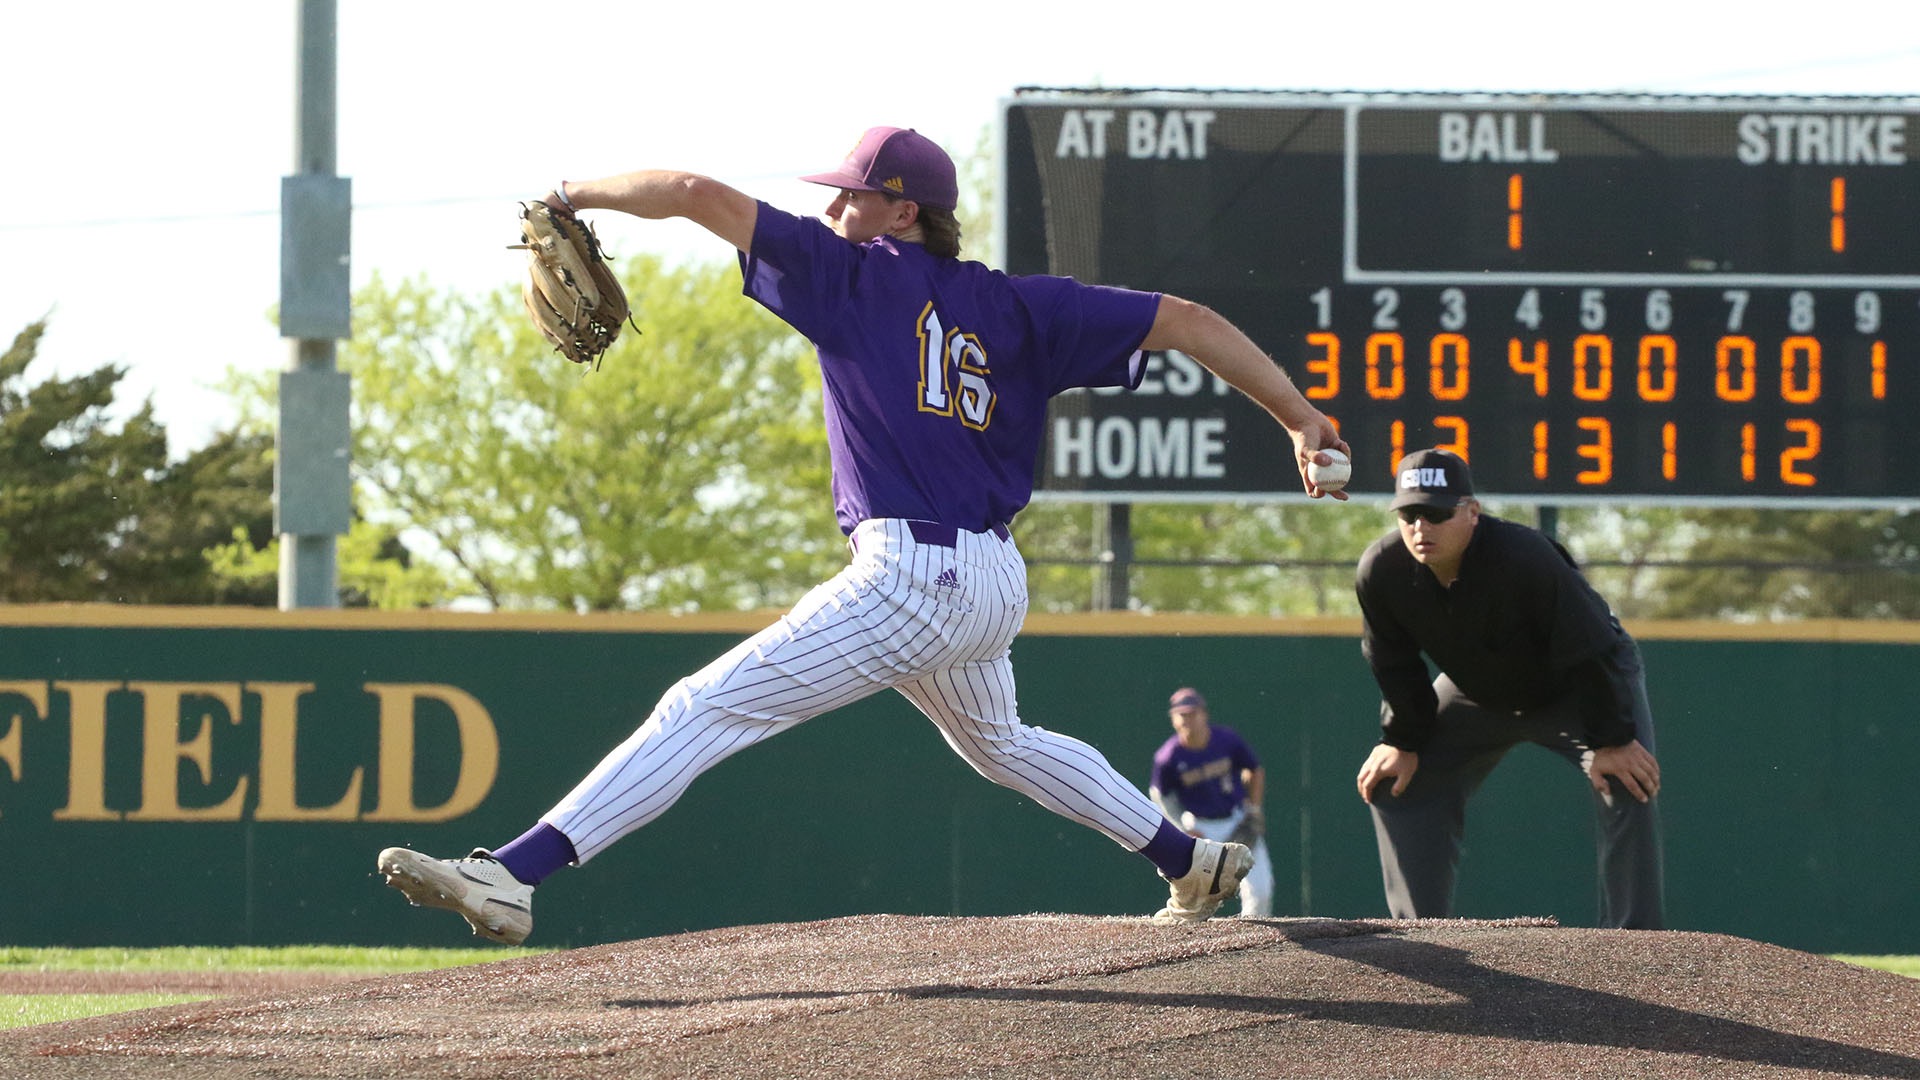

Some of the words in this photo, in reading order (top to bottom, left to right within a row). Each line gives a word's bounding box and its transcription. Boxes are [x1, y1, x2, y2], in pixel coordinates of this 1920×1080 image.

[1055, 108, 1116, 159] AT
[1126, 109, 1217, 160] BAT
[1438, 112, 1559, 163] BALL
[1736, 113, 1908, 166] STRIKE
[1508, 174, 1523, 250] 1
[1830, 176, 1846, 253] 1
[1310, 287, 1332, 329] 1
[1373, 288, 1399, 330] 2
[1440, 288, 1467, 331] 3
[1515, 288, 1541, 330] 4
[1580, 289, 1606, 331] 5
[1645, 289, 1672, 332] 6
[1723, 290, 1750, 331] 7
[1788, 290, 1815, 333] 8
[1854, 290, 1881, 334] 9
[916, 300, 998, 432] 16
[1305, 332, 1341, 400] 3
[1364, 332, 1406, 401] 0
[1429, 333, 1470, 402] 0
[1508, 337, 1549, 398] 4
[1572, 334, 1613, 402] 0
[1637, 334, 1678, 402] 0
[1715, 335, 1757, 402] 0
[1780, 336, 1822, 404] 0
[1870, 340, 1887, 400] 1
[1053, 416, 1226, 479] HOME
[1390, 419, 1405, 478] 1
[1533, 420, 1549, 480] 1
[1576, 416, 1613, 486] 3
[1662, 421, 1678, 481] 1
[1740, 422, 1756, 482] 1
[1779, 418, 1822, 487] 2
